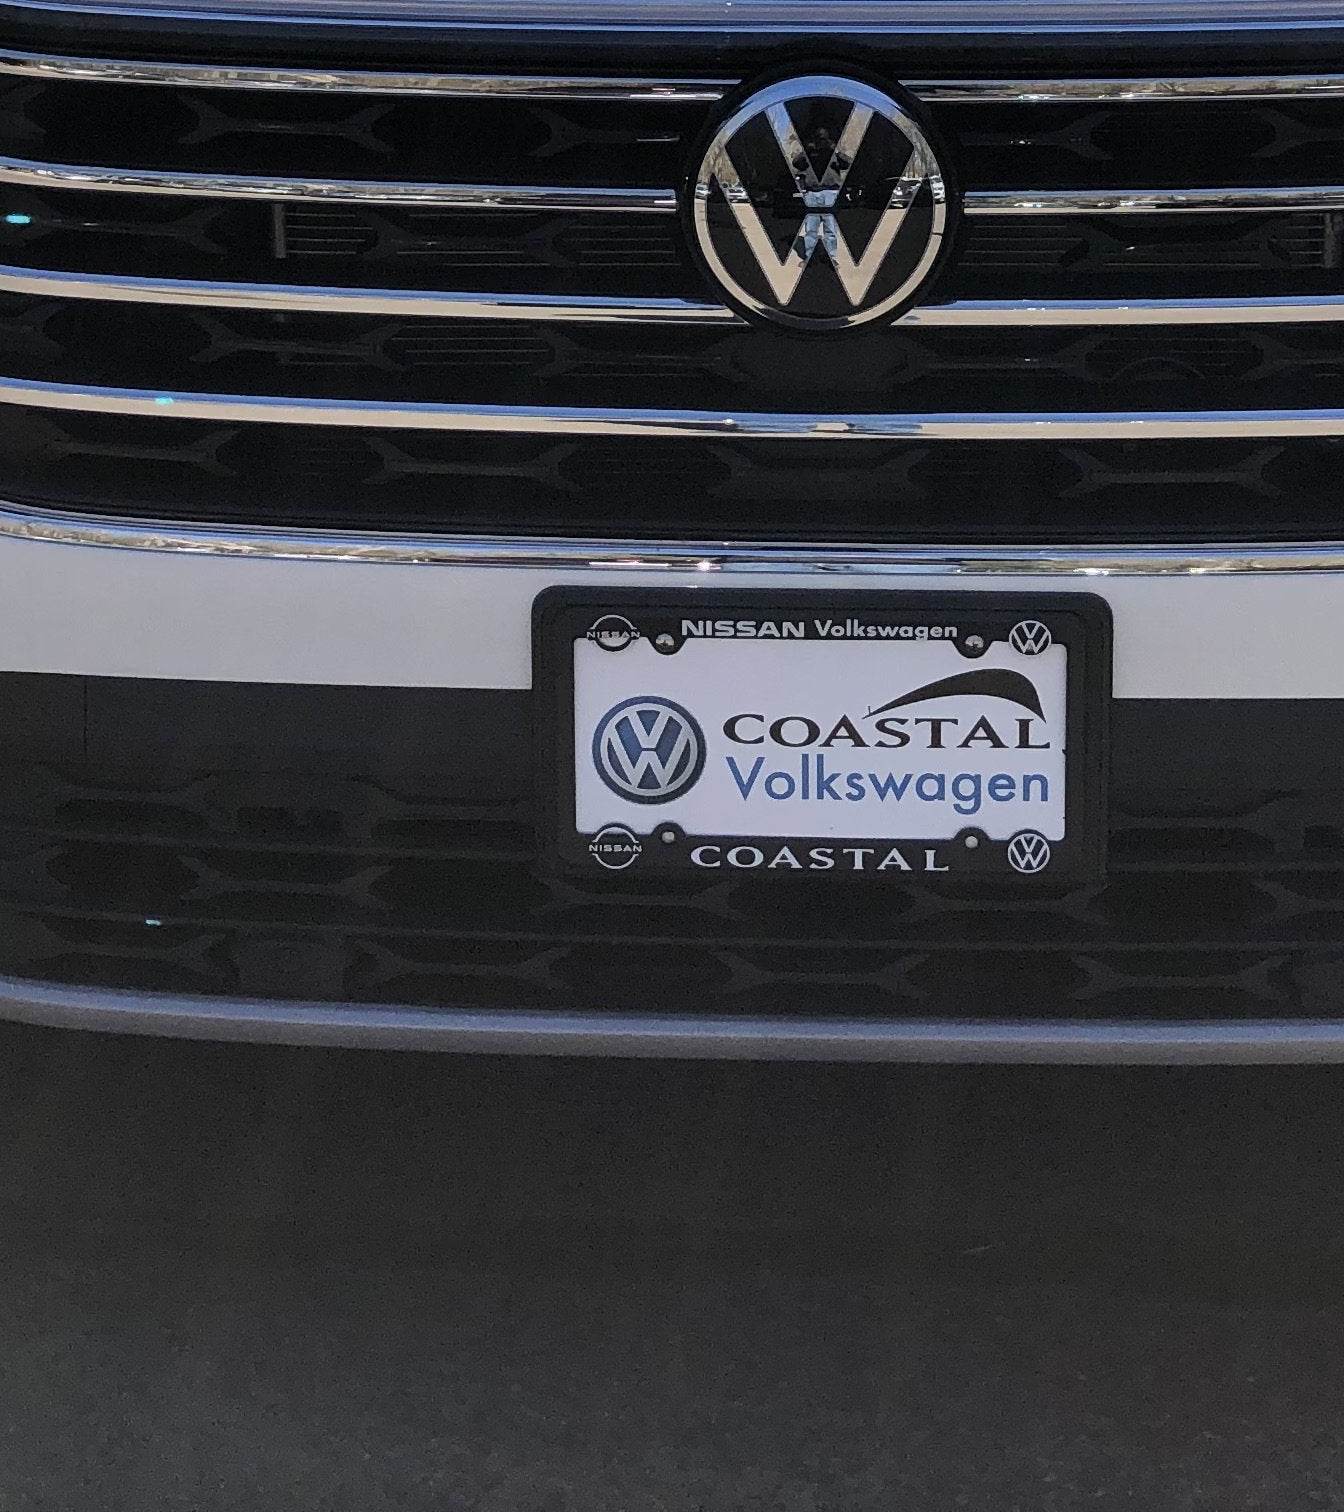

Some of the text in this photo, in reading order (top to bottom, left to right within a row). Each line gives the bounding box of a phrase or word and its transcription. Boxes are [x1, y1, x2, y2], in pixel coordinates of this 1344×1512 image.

[700, 86, 940, 318] VW
[681, 619, 958, 641] NISSAN Volkswagen
[722, 713, 1051, 749] COASTAL
[598, 701, 701, 799] VW
[725, 753, 1049, 815] Volkswagen
[588, 843, 643, 853] NISSAN
[690, 845, 950, 872] COASTAL
